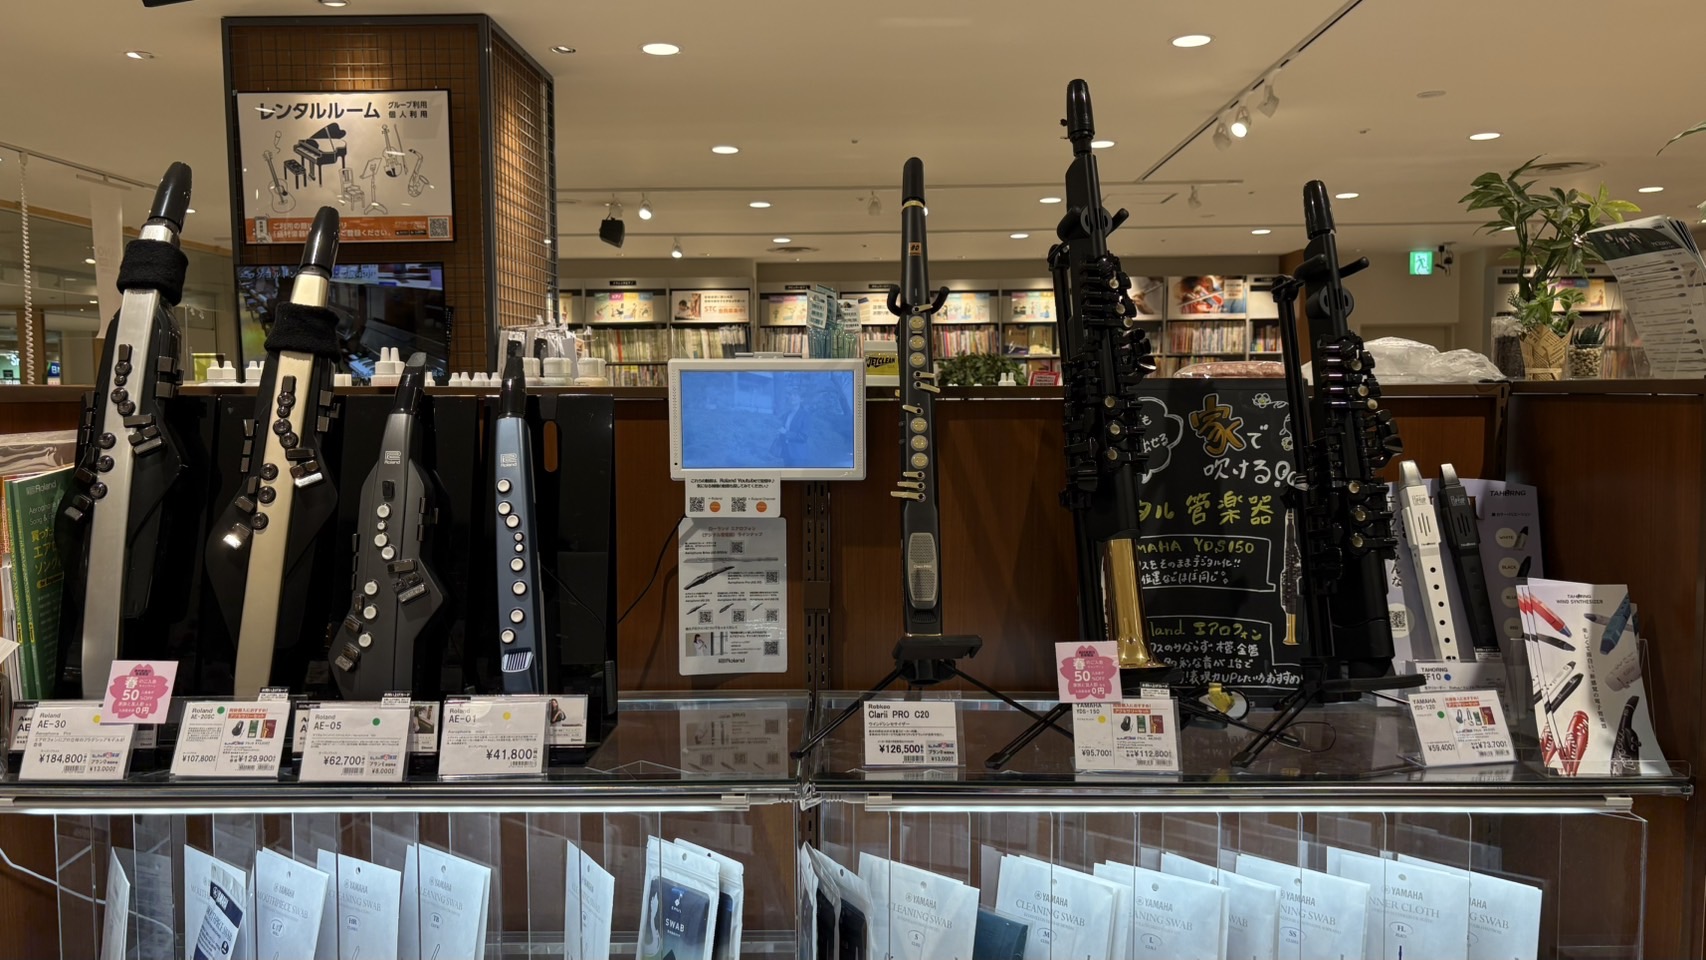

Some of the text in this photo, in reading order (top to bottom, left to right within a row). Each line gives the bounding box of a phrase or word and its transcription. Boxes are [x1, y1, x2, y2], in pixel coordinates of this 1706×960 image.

[258, 102, 381, 120] レンタルルーム
[388, 100, 428, 109] グループ利用
[388, 110, 428, 119] 個人利用
[1074, 671, 1090, 682] 50
[122, 689, 140, 701] 50
[448, 715, 476, 723] AE-01
[868, 710, 930, 719] Clarii PRO C20
[37, 719, 66, 729] AE-30
[314, 721, 342, 730] AE-05
[486, 749, 532, 760] ¥41,800
[879, 745, 920, 754] ¥126,500
[39, 754, 83, 763] ¥184,800
[324, 756, 361, 765] ¥62,700
[349, 880, 368, 894] YAMAHA
[435, 879, 452, 892] YAMAHA
[1043, 892, 1068, 908] YAMAHA
[1286, 891, 1315, 906] YAMAHA
[1391, 887, 1423, 901] YAMAHA
[362, 900, 381, 912] SWAB
[444, 897, 463, 911] SWAB
[913, 894, 937, 910] YAMAHA
[1144, 898, 1173, 912] YAMAHA
[888, 901, 952, 929] CLEANING SWAB
[1016, 899, 1085, 927] CLEANING SWAB
[1400, 902, 1440, 918] CLOTH
[665, 918, 685, 932] SWAB
[1164, 916, 1193, 931] SWAB
[1308, 911, 1336, 926] SWAB
[1478, 914, 1509, 929] SWAB
[1043, 930, 1050, 938] M
